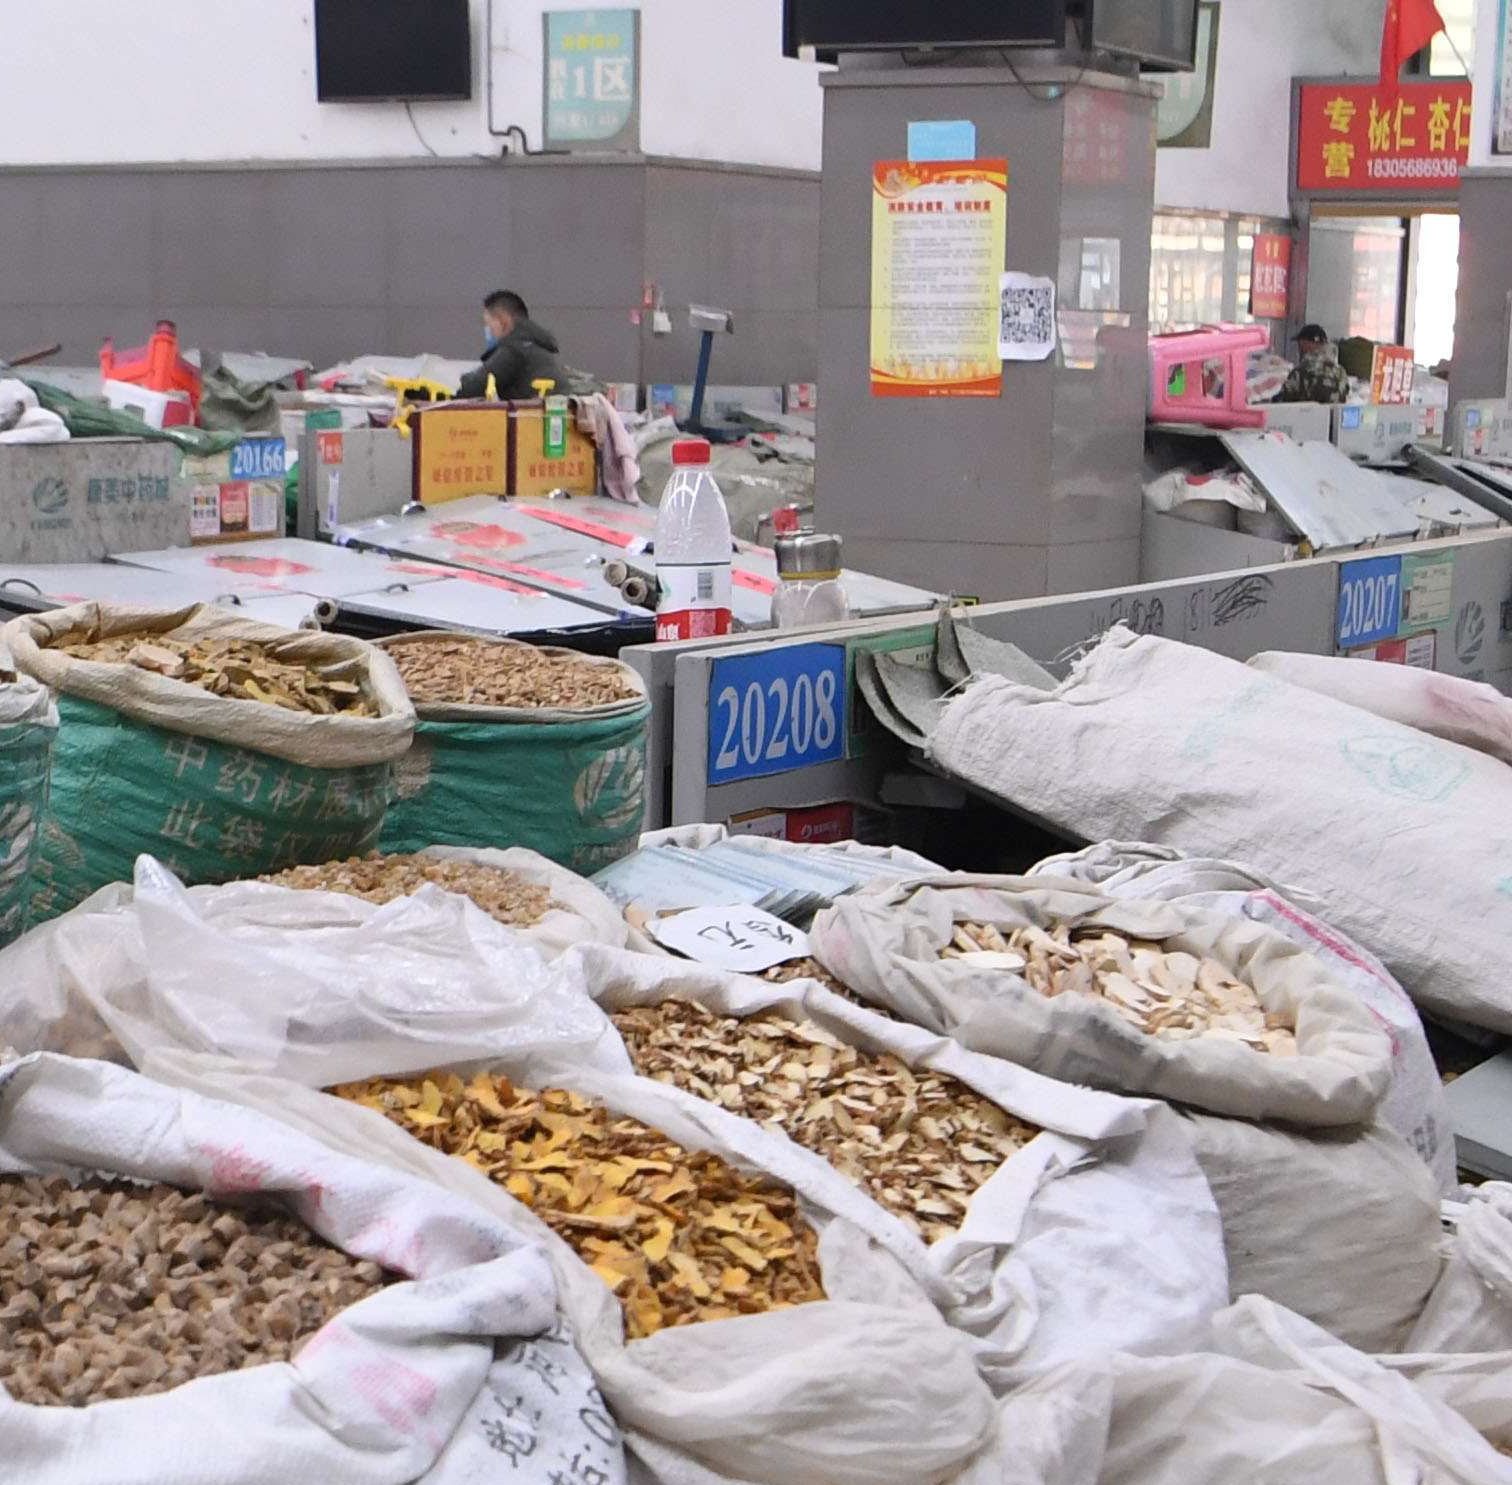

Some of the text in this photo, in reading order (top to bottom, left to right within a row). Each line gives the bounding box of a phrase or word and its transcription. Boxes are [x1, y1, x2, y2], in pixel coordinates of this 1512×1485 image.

[1322, 97, 1356, 179] 专营
[1340, 574, 1398, 639] 20207
[714, 669, 837, 771] 20208
